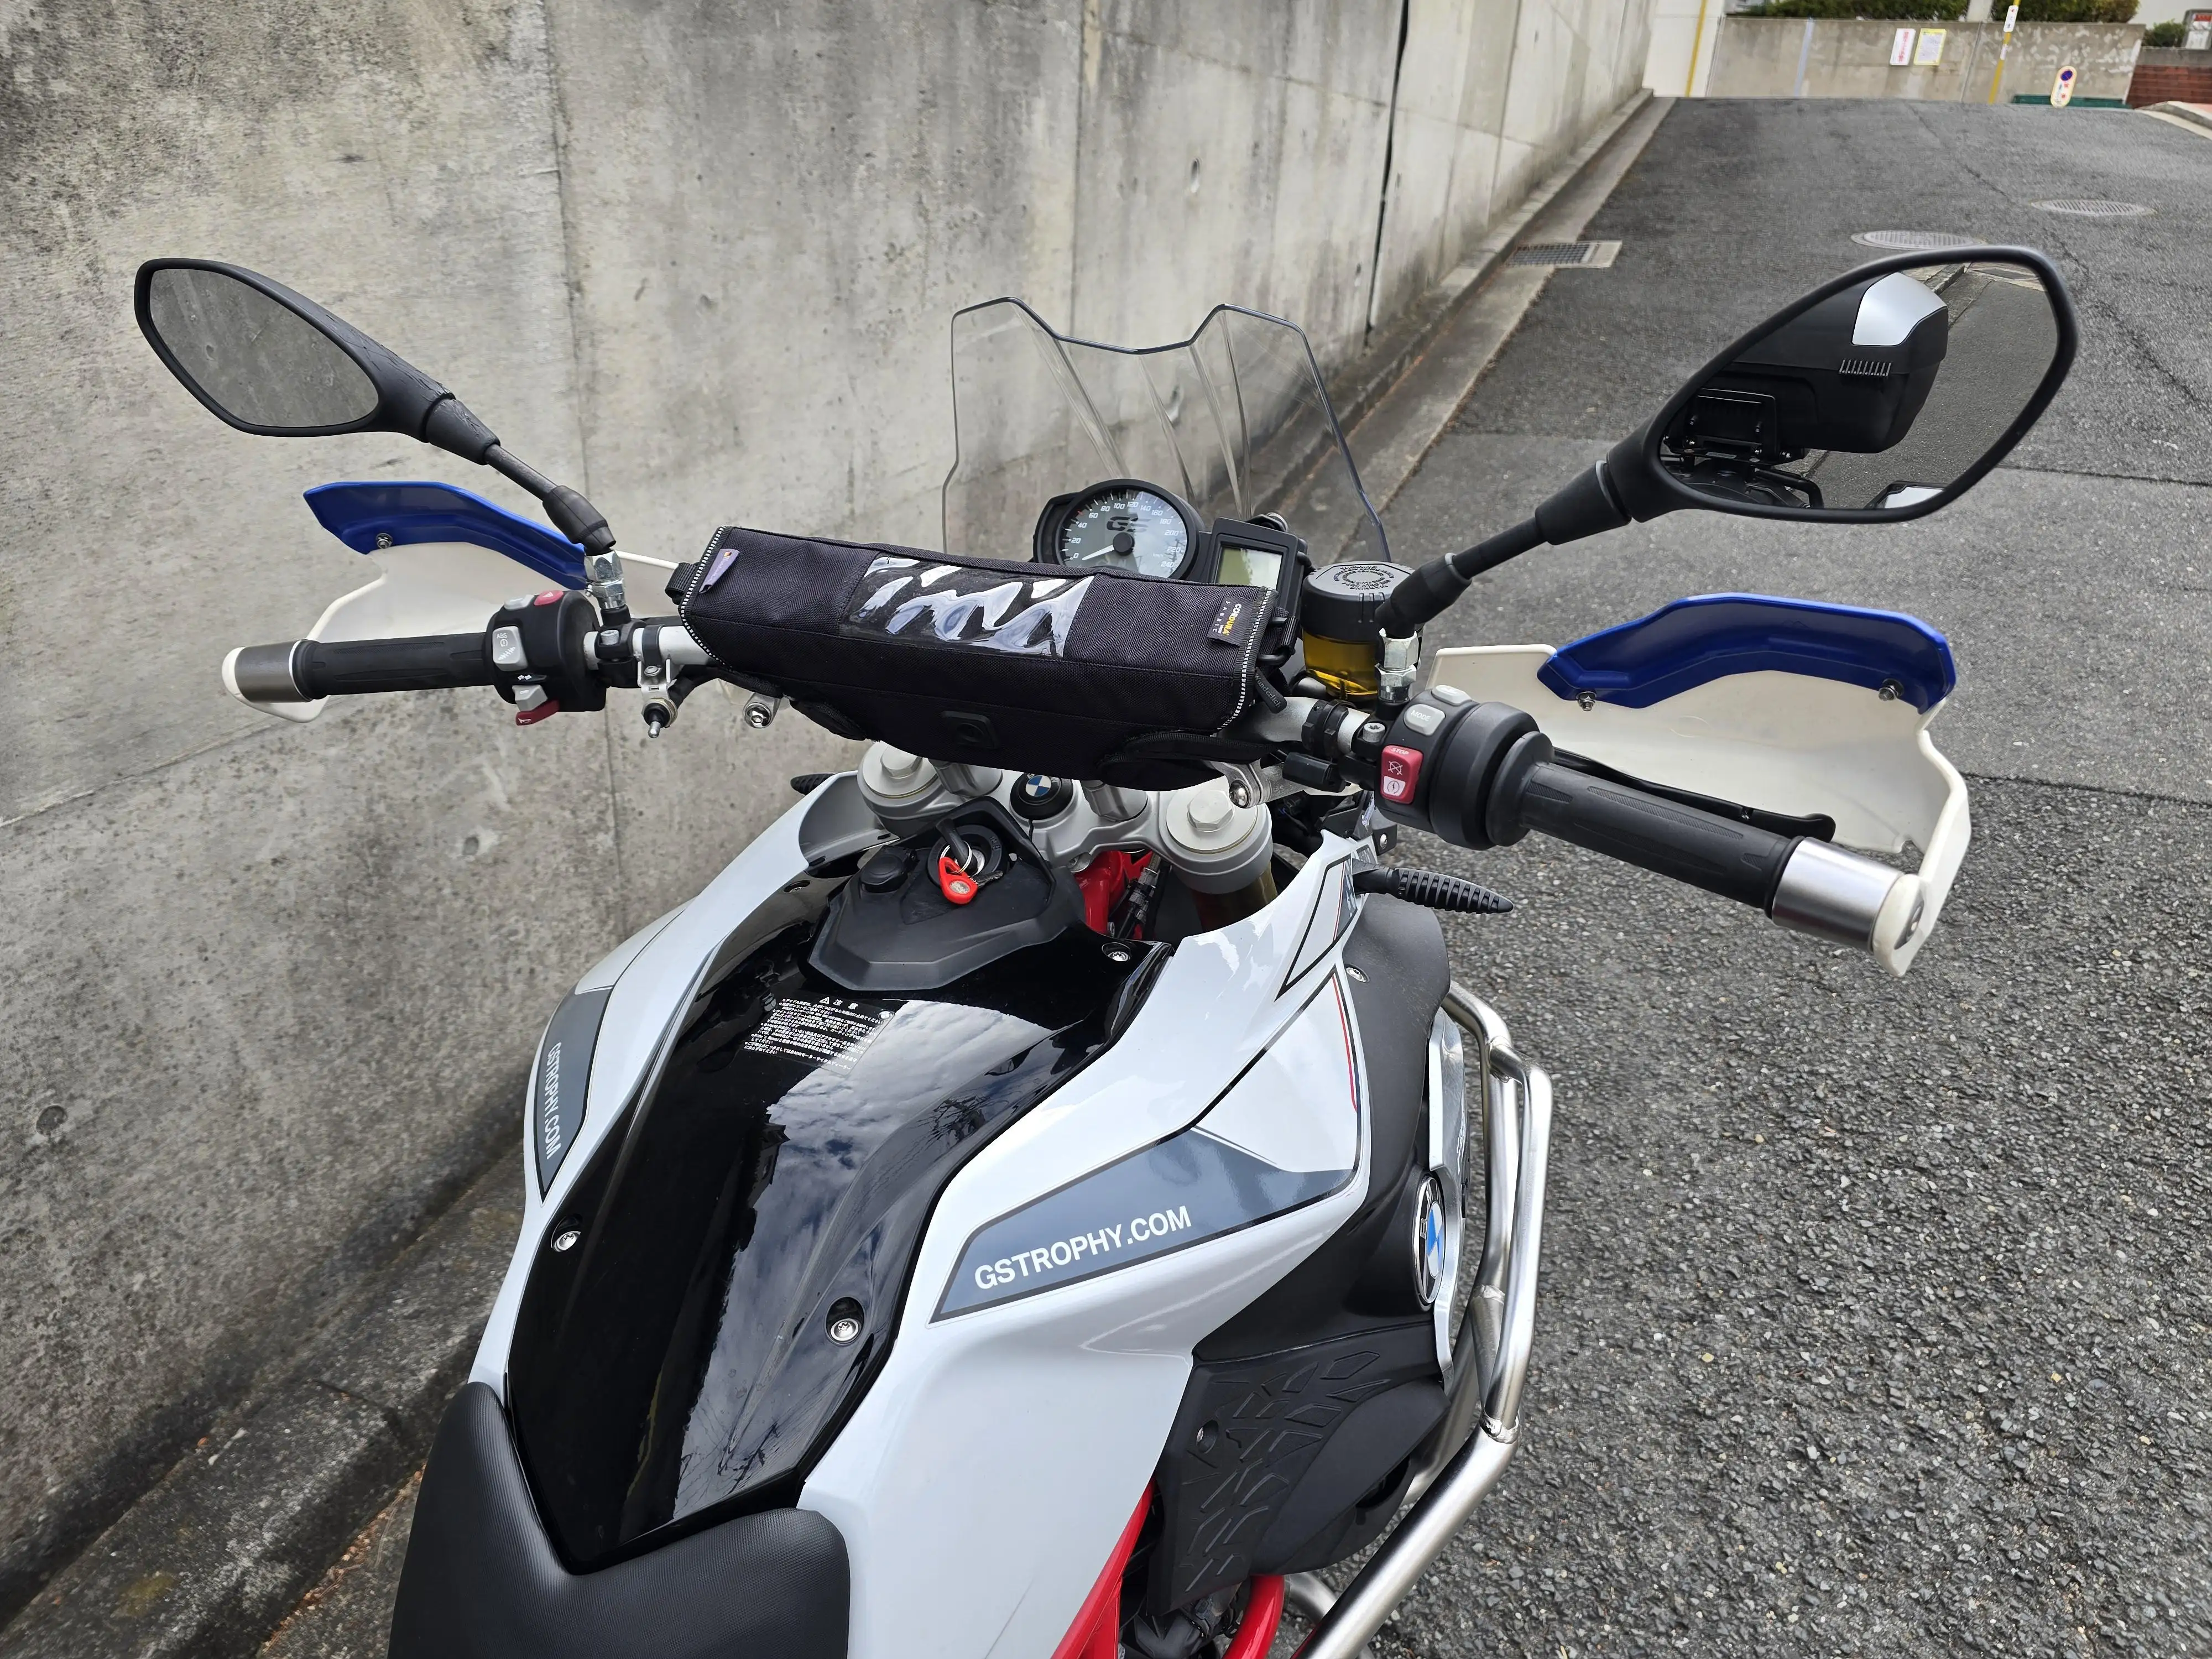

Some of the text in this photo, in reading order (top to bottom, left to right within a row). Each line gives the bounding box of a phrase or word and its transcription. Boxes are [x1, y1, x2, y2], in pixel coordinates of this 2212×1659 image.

[1212, 601, 1230, 632] FABRIC
[1222, 603, 1242, 635] CORDURA
[1411, 710, 1431, 721] MODE
[544, 1042, 562, 1160] GSTROPHY.COM
[974, 1206, 1192, 1289] GSTROPHY.COM
